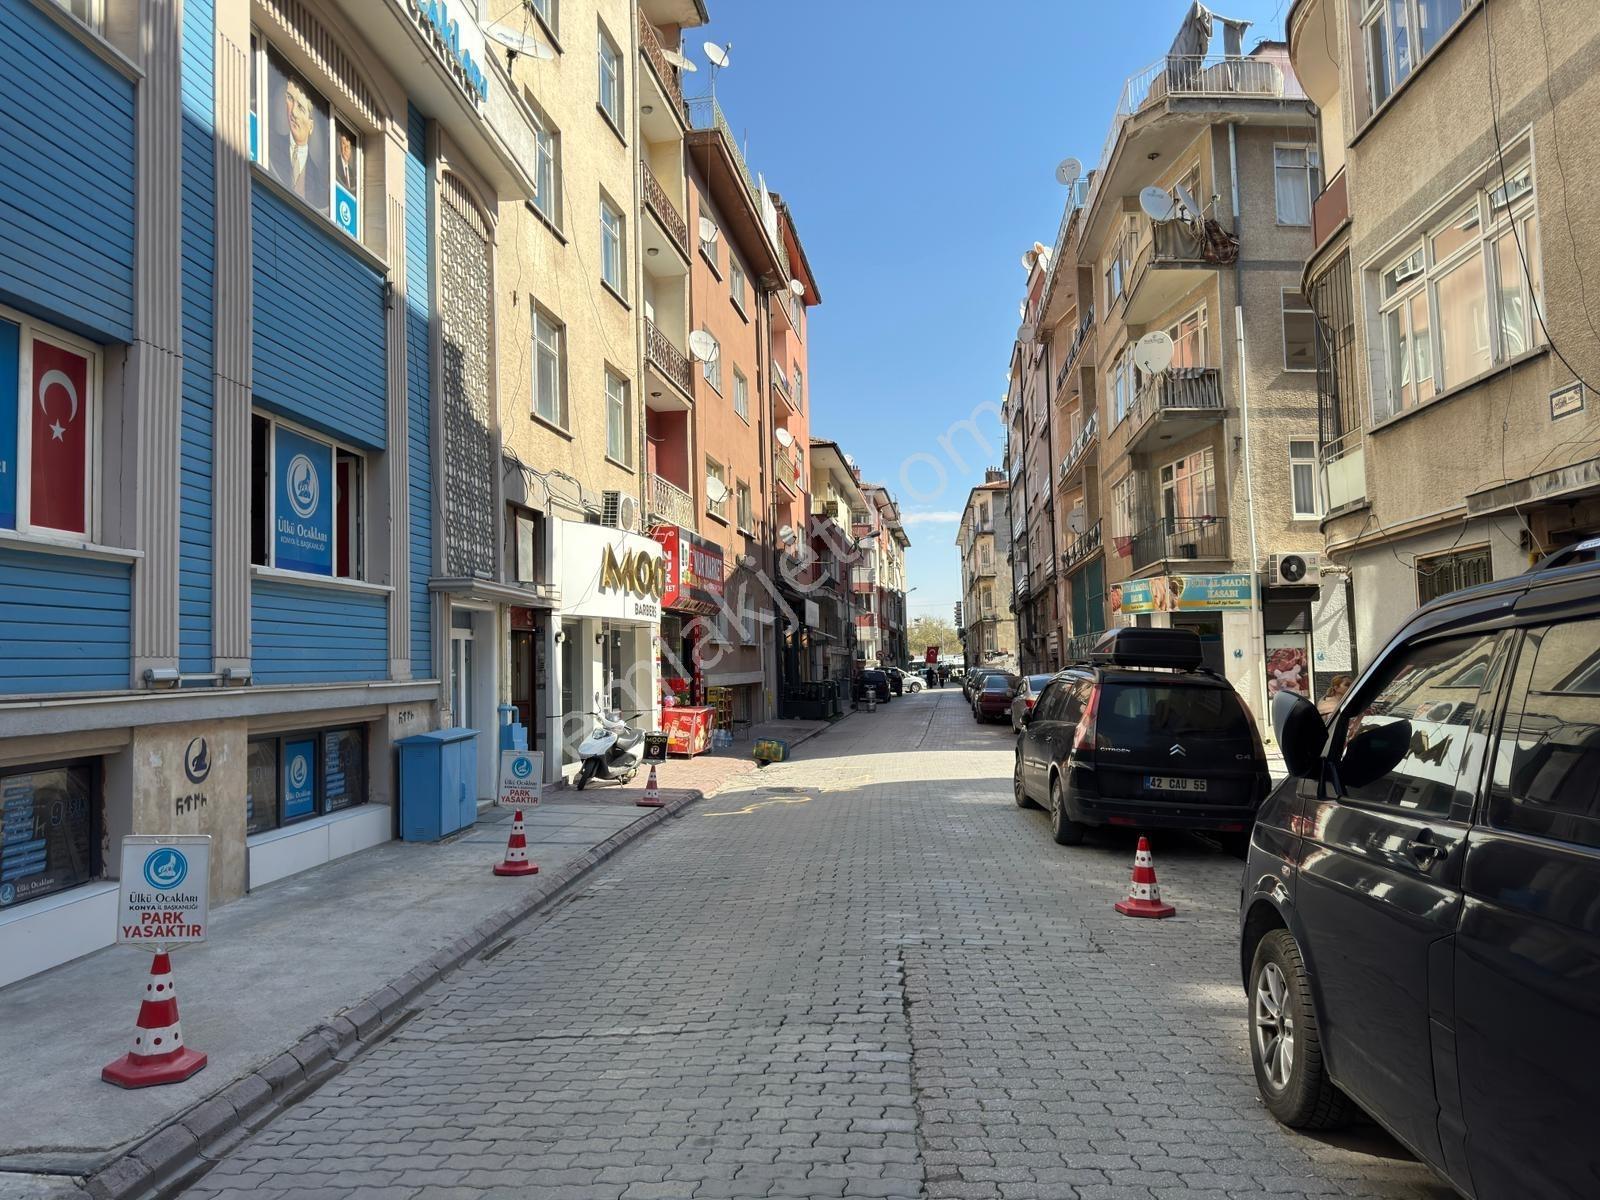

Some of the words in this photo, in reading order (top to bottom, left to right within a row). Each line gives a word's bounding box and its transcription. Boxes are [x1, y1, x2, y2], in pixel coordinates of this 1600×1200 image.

[1151, 777, 1162, 788] 42
[1169, 779, 1187, 789] CAU
[1193, 780, 1206, 790] 55
[510, 789, 530, 797] PARK
[501, 796, 538, 804] YASAKTIR
[129, 891, 152, 903] Ülkü
[155, 893, 198, 903] Ocakları
[141, 912, 184, 925] PARK
[122, 924, 202, 938] YASAKTIR
